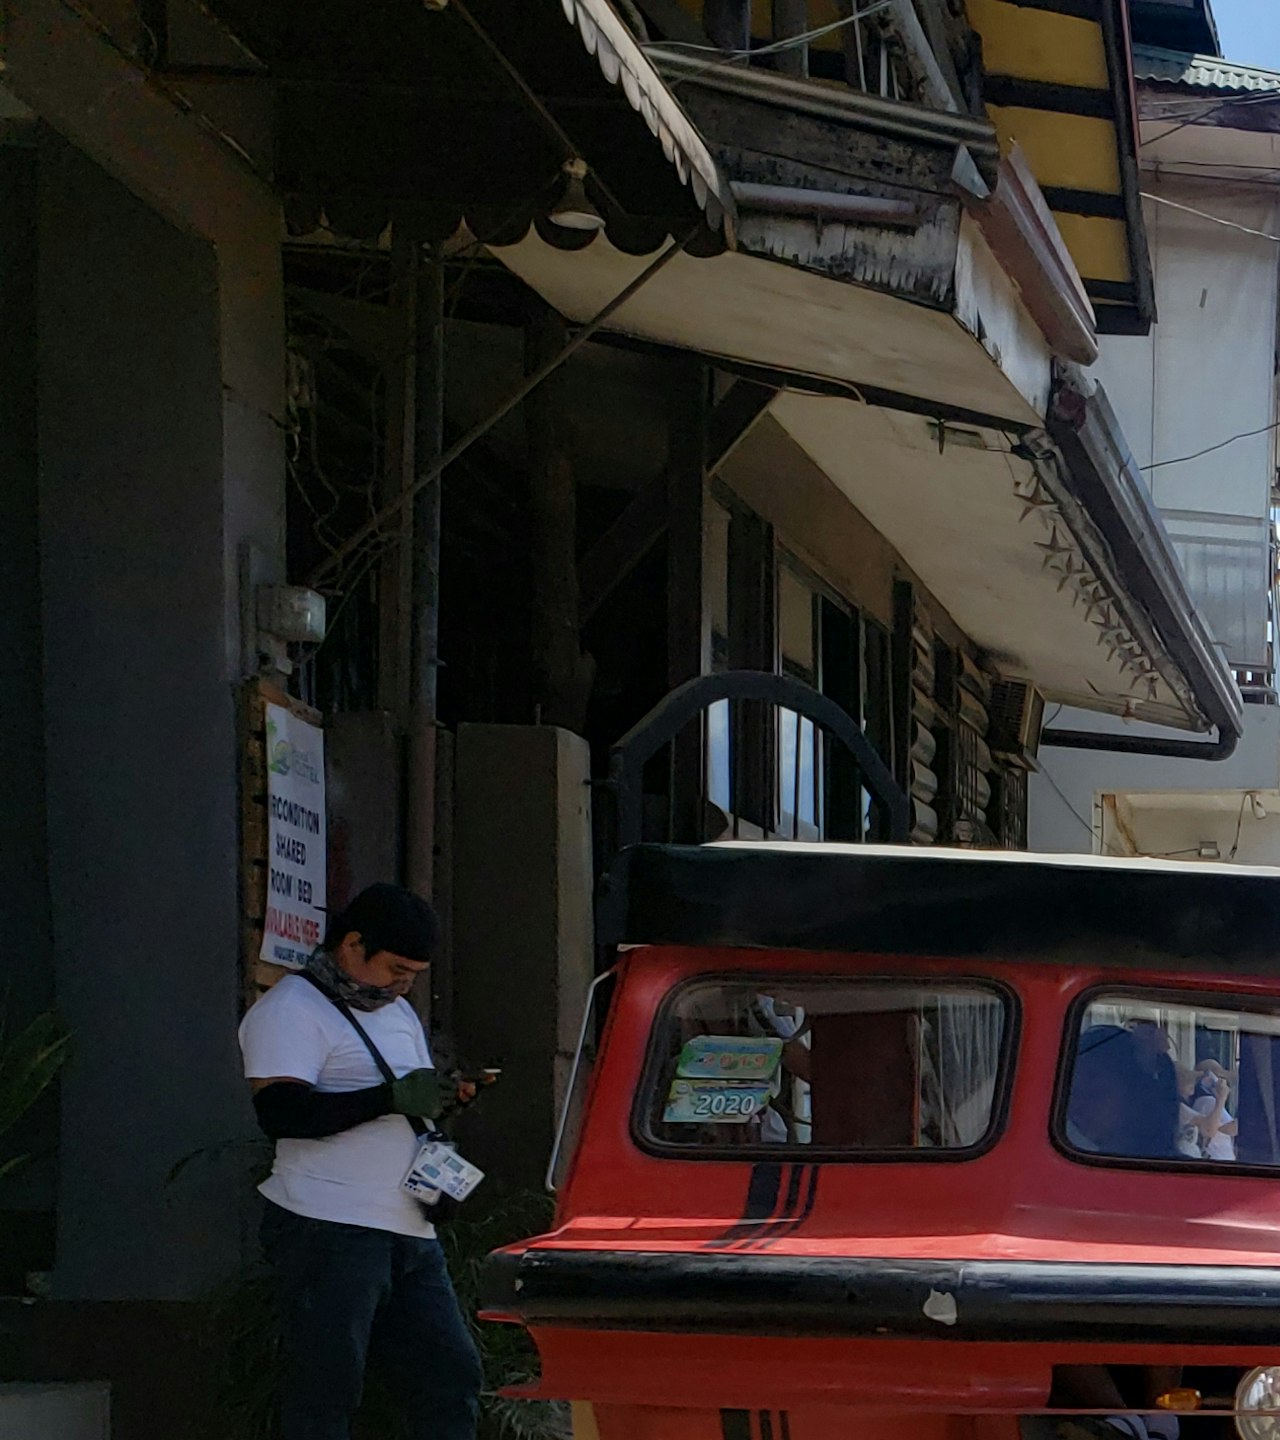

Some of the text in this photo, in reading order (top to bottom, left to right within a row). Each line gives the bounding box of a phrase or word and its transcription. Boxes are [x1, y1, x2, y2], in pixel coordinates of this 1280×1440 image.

[275, 833, 307, 866] SHARED
[297, 877, 314, 904] BED
[694, 1094, 755, 1115] 2020
